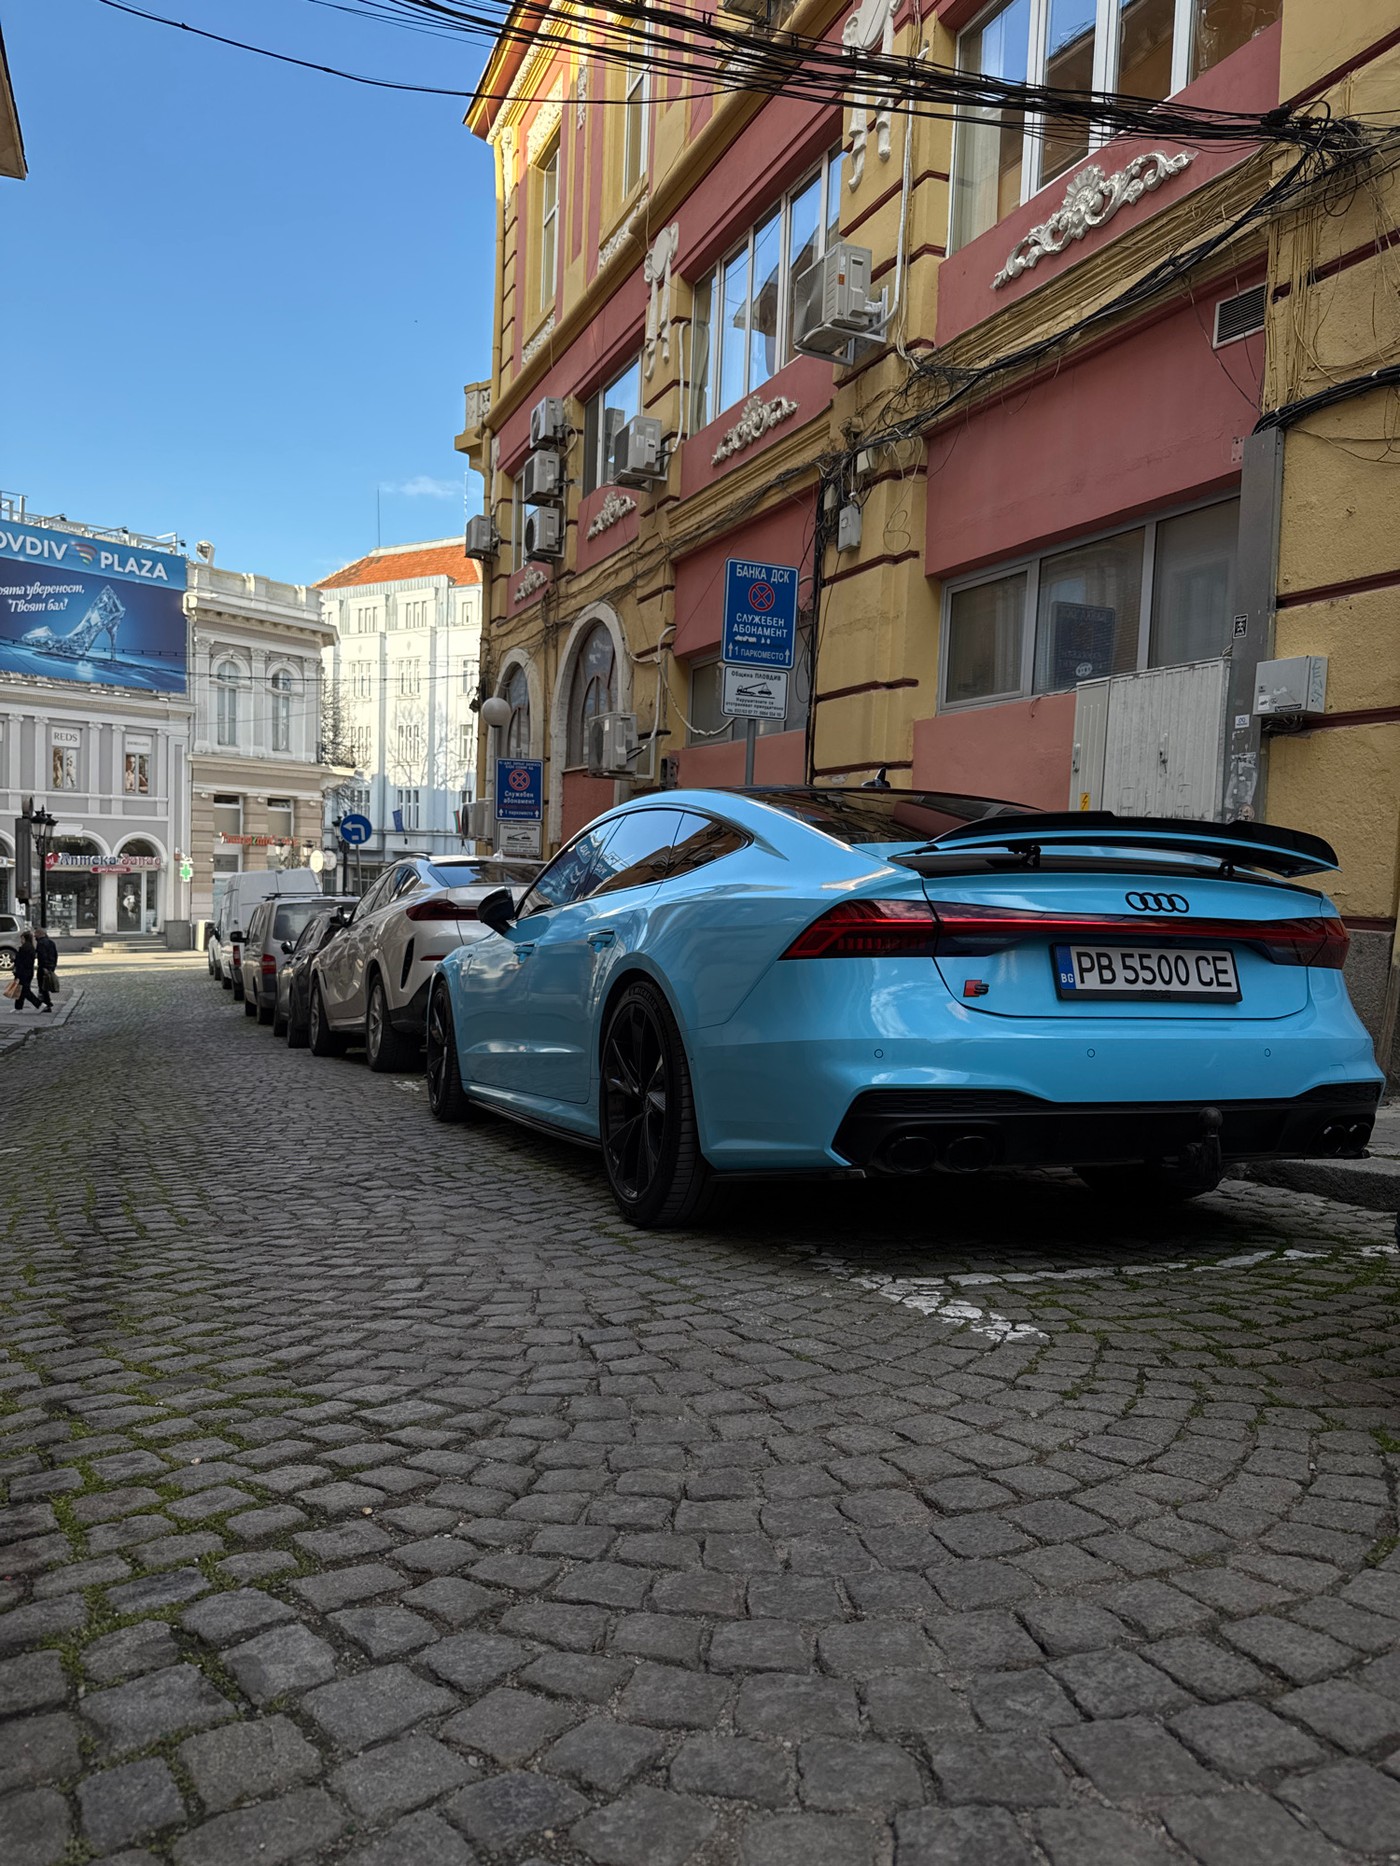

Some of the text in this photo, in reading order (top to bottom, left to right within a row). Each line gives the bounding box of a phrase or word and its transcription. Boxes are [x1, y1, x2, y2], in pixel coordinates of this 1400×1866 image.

[100, 551, 169, 581] PLAZA
[736, 564, 790, 584] БАНКА ДСК
[25, 581, 85, 600] увереност,
[8, 598, 69, 613] Твоят бал!
[736, 613, 785, 627] СЛУЖЕБЕН
[732, 623, 788, 638] АБОНАМЕНТ
[734, 646, 784, 660] 1 ПАРКОМЕСТО
[731, 670, 781, 681] Община ПЛОВДИВ
[54, 732, 78, 742] REDS
[504, 790, 534, 798] Служебен
[59, 853, 118, 866] Аптека
[1075, 951, 1232, 988] PB 5500 CE
[1060, 973, 1074, 984] BG
